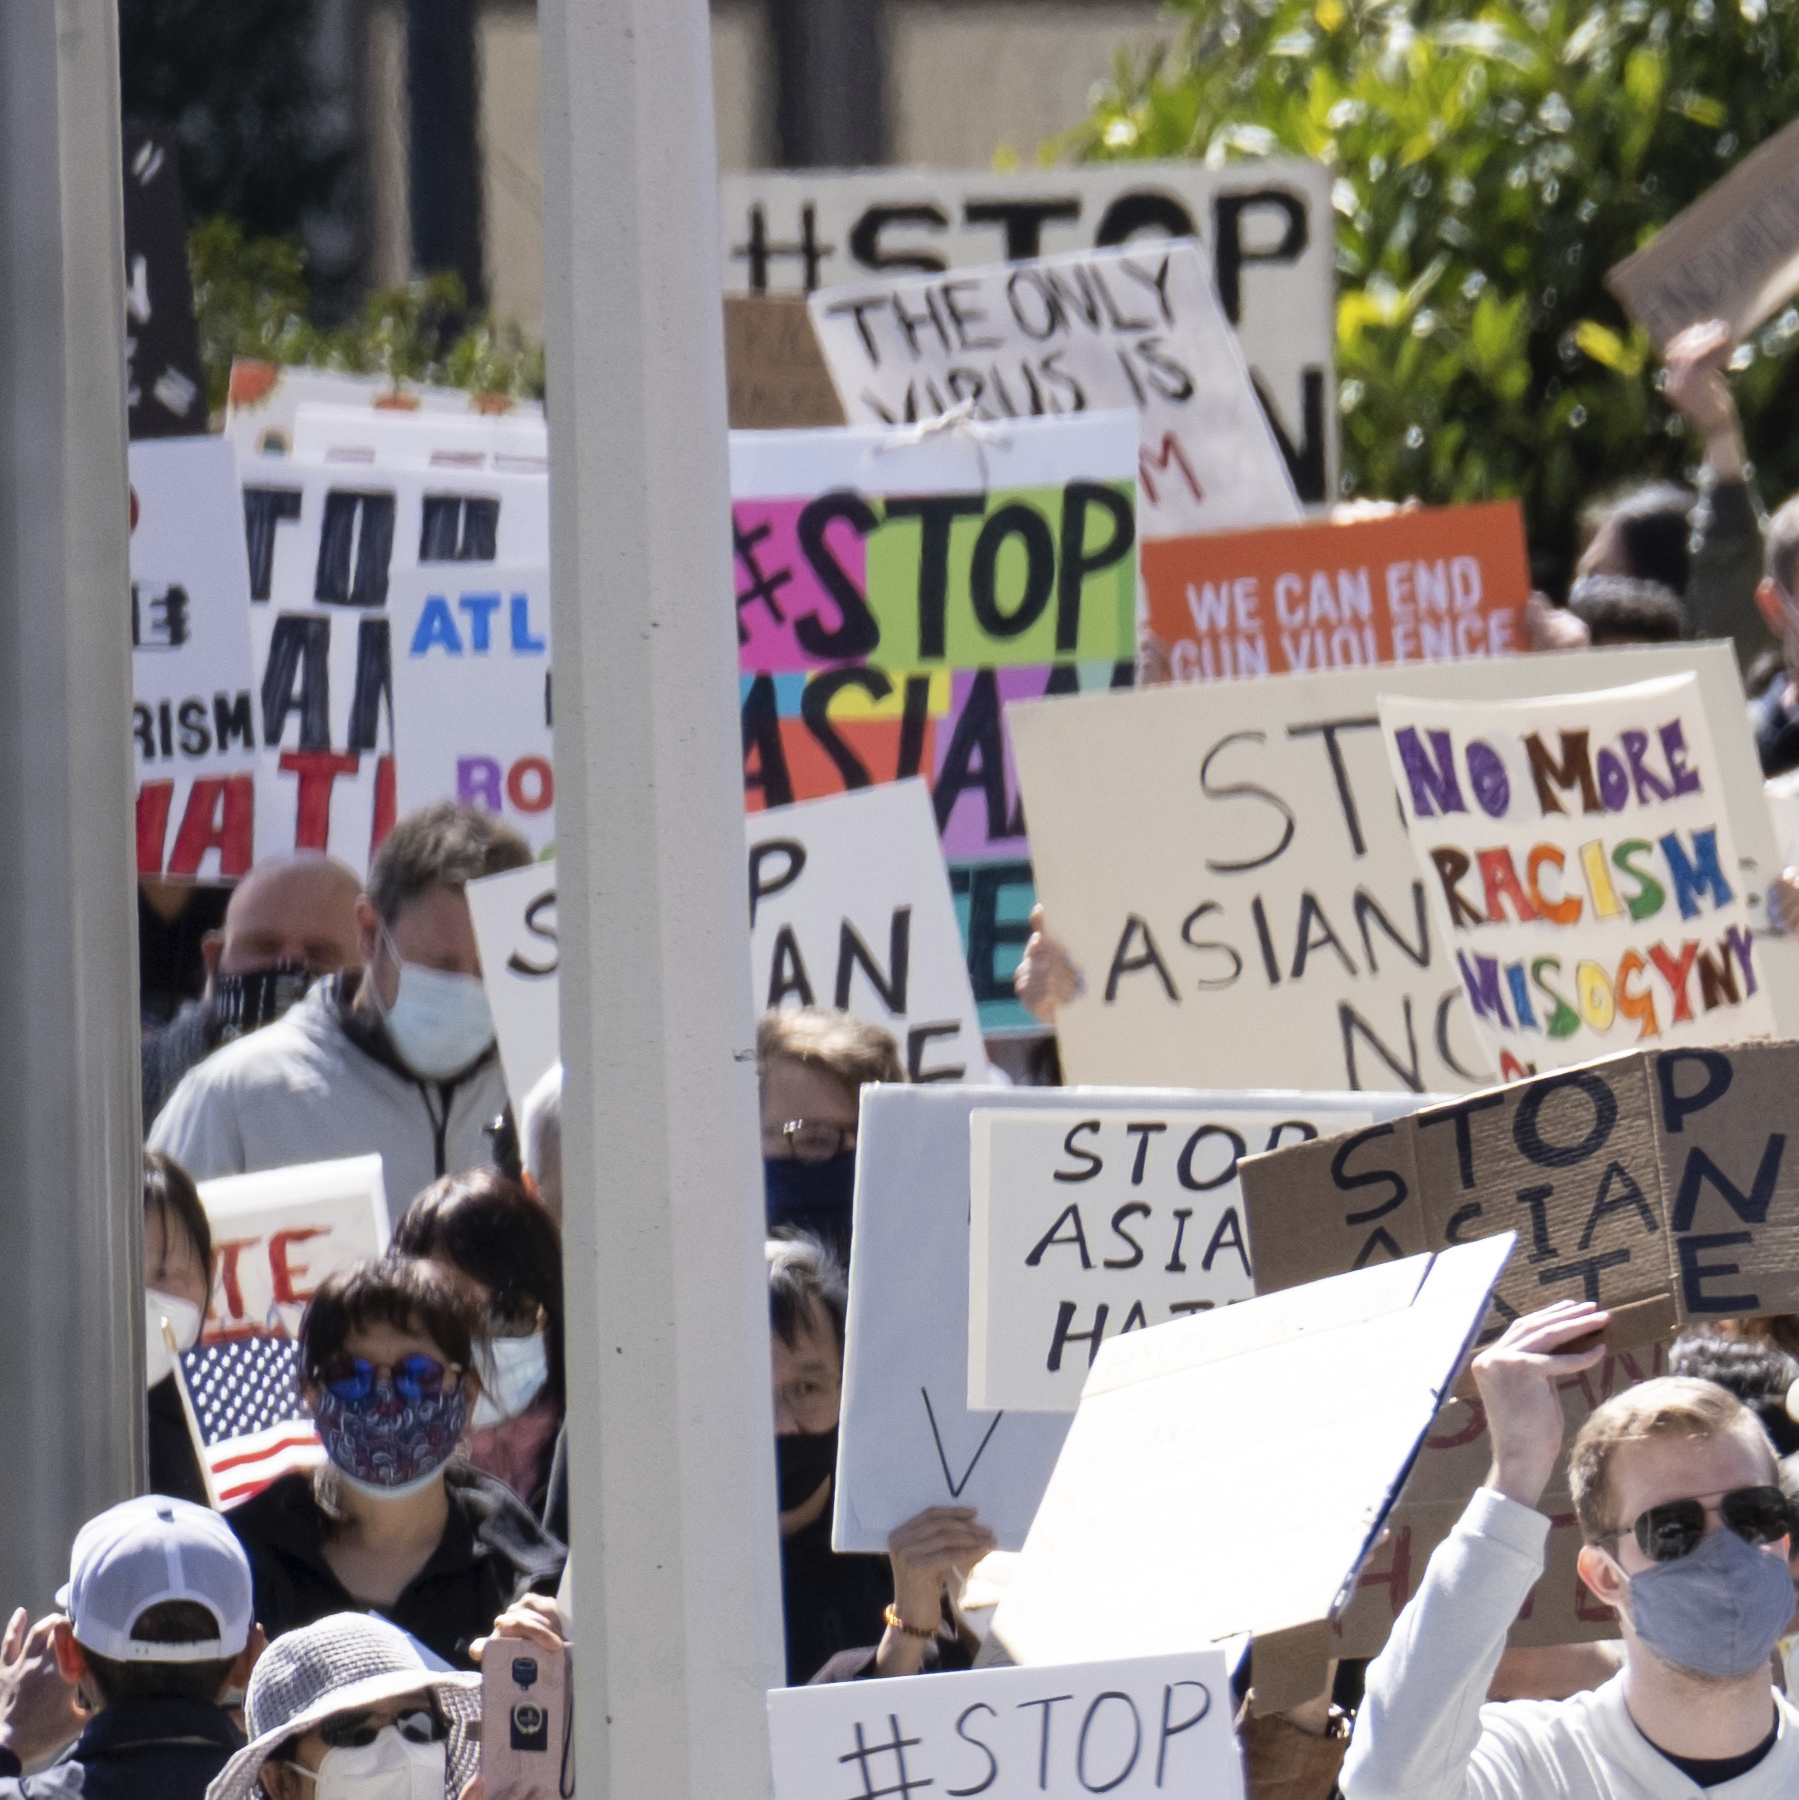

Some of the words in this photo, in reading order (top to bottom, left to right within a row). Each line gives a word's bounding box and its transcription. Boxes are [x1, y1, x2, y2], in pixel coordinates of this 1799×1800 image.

[825, 279, 1005, 366] THE
[1005, 255, 1174, 342] ONLY
[1117, 334, 1196, 405] IS
[734, 481, 1136, 661] #STOP
[1186, 577, 1262, 633] WE
[1273, 564, 1375, 625] CAN
[1387, 555, 1484, 617] END
[1394, 725, 1511, 818] NO
[1524, 717, 1705, 818] MORE
[1428, 822, 1734, 929] RACISM
[1104, 877, 1430, 1005] ASIAN
[1456, 925, 1757, 1041] MISOGYNY
[1331, 1047, 1734, 1228] STOP
